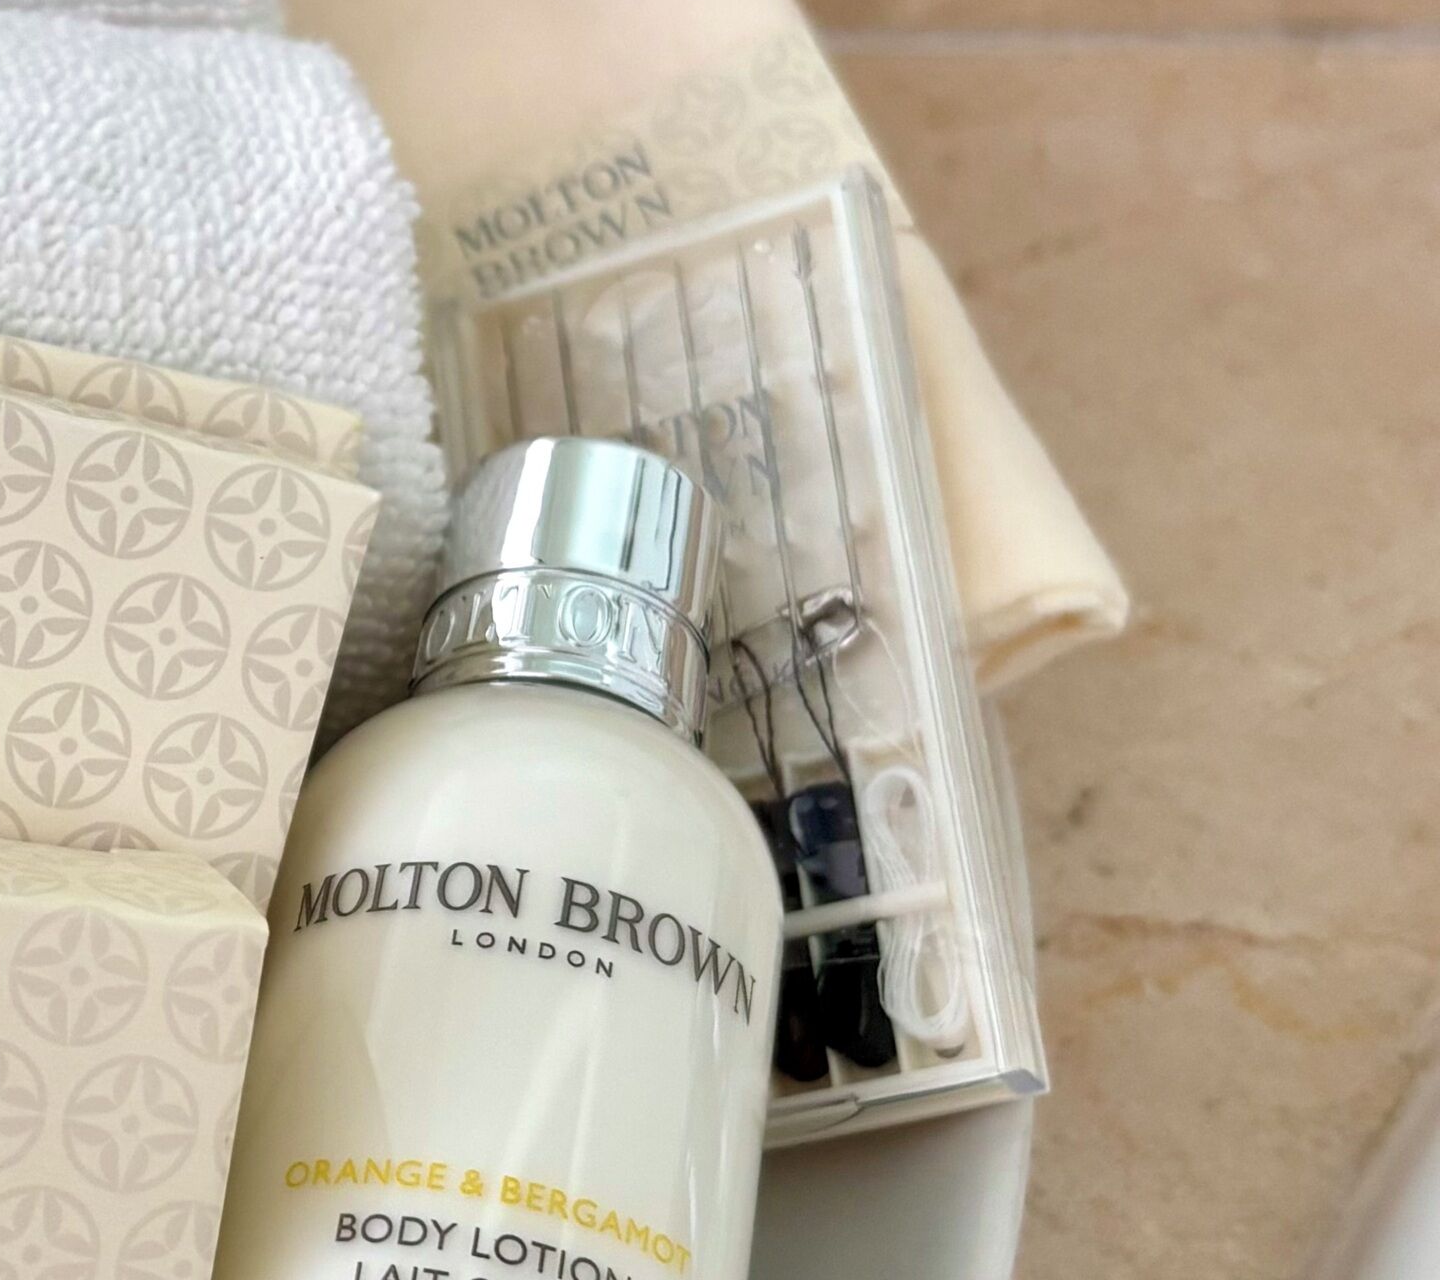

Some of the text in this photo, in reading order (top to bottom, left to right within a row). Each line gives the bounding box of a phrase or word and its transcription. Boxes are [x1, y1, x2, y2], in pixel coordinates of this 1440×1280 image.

[293, 861, 756, 1026] MOLTON BROWN
[451, 929, 614, 978] LONDON
[285, 1158, 692, 1275] ORANGE & BERGAMOT
[335, 1213, 458, 1251] BODY
